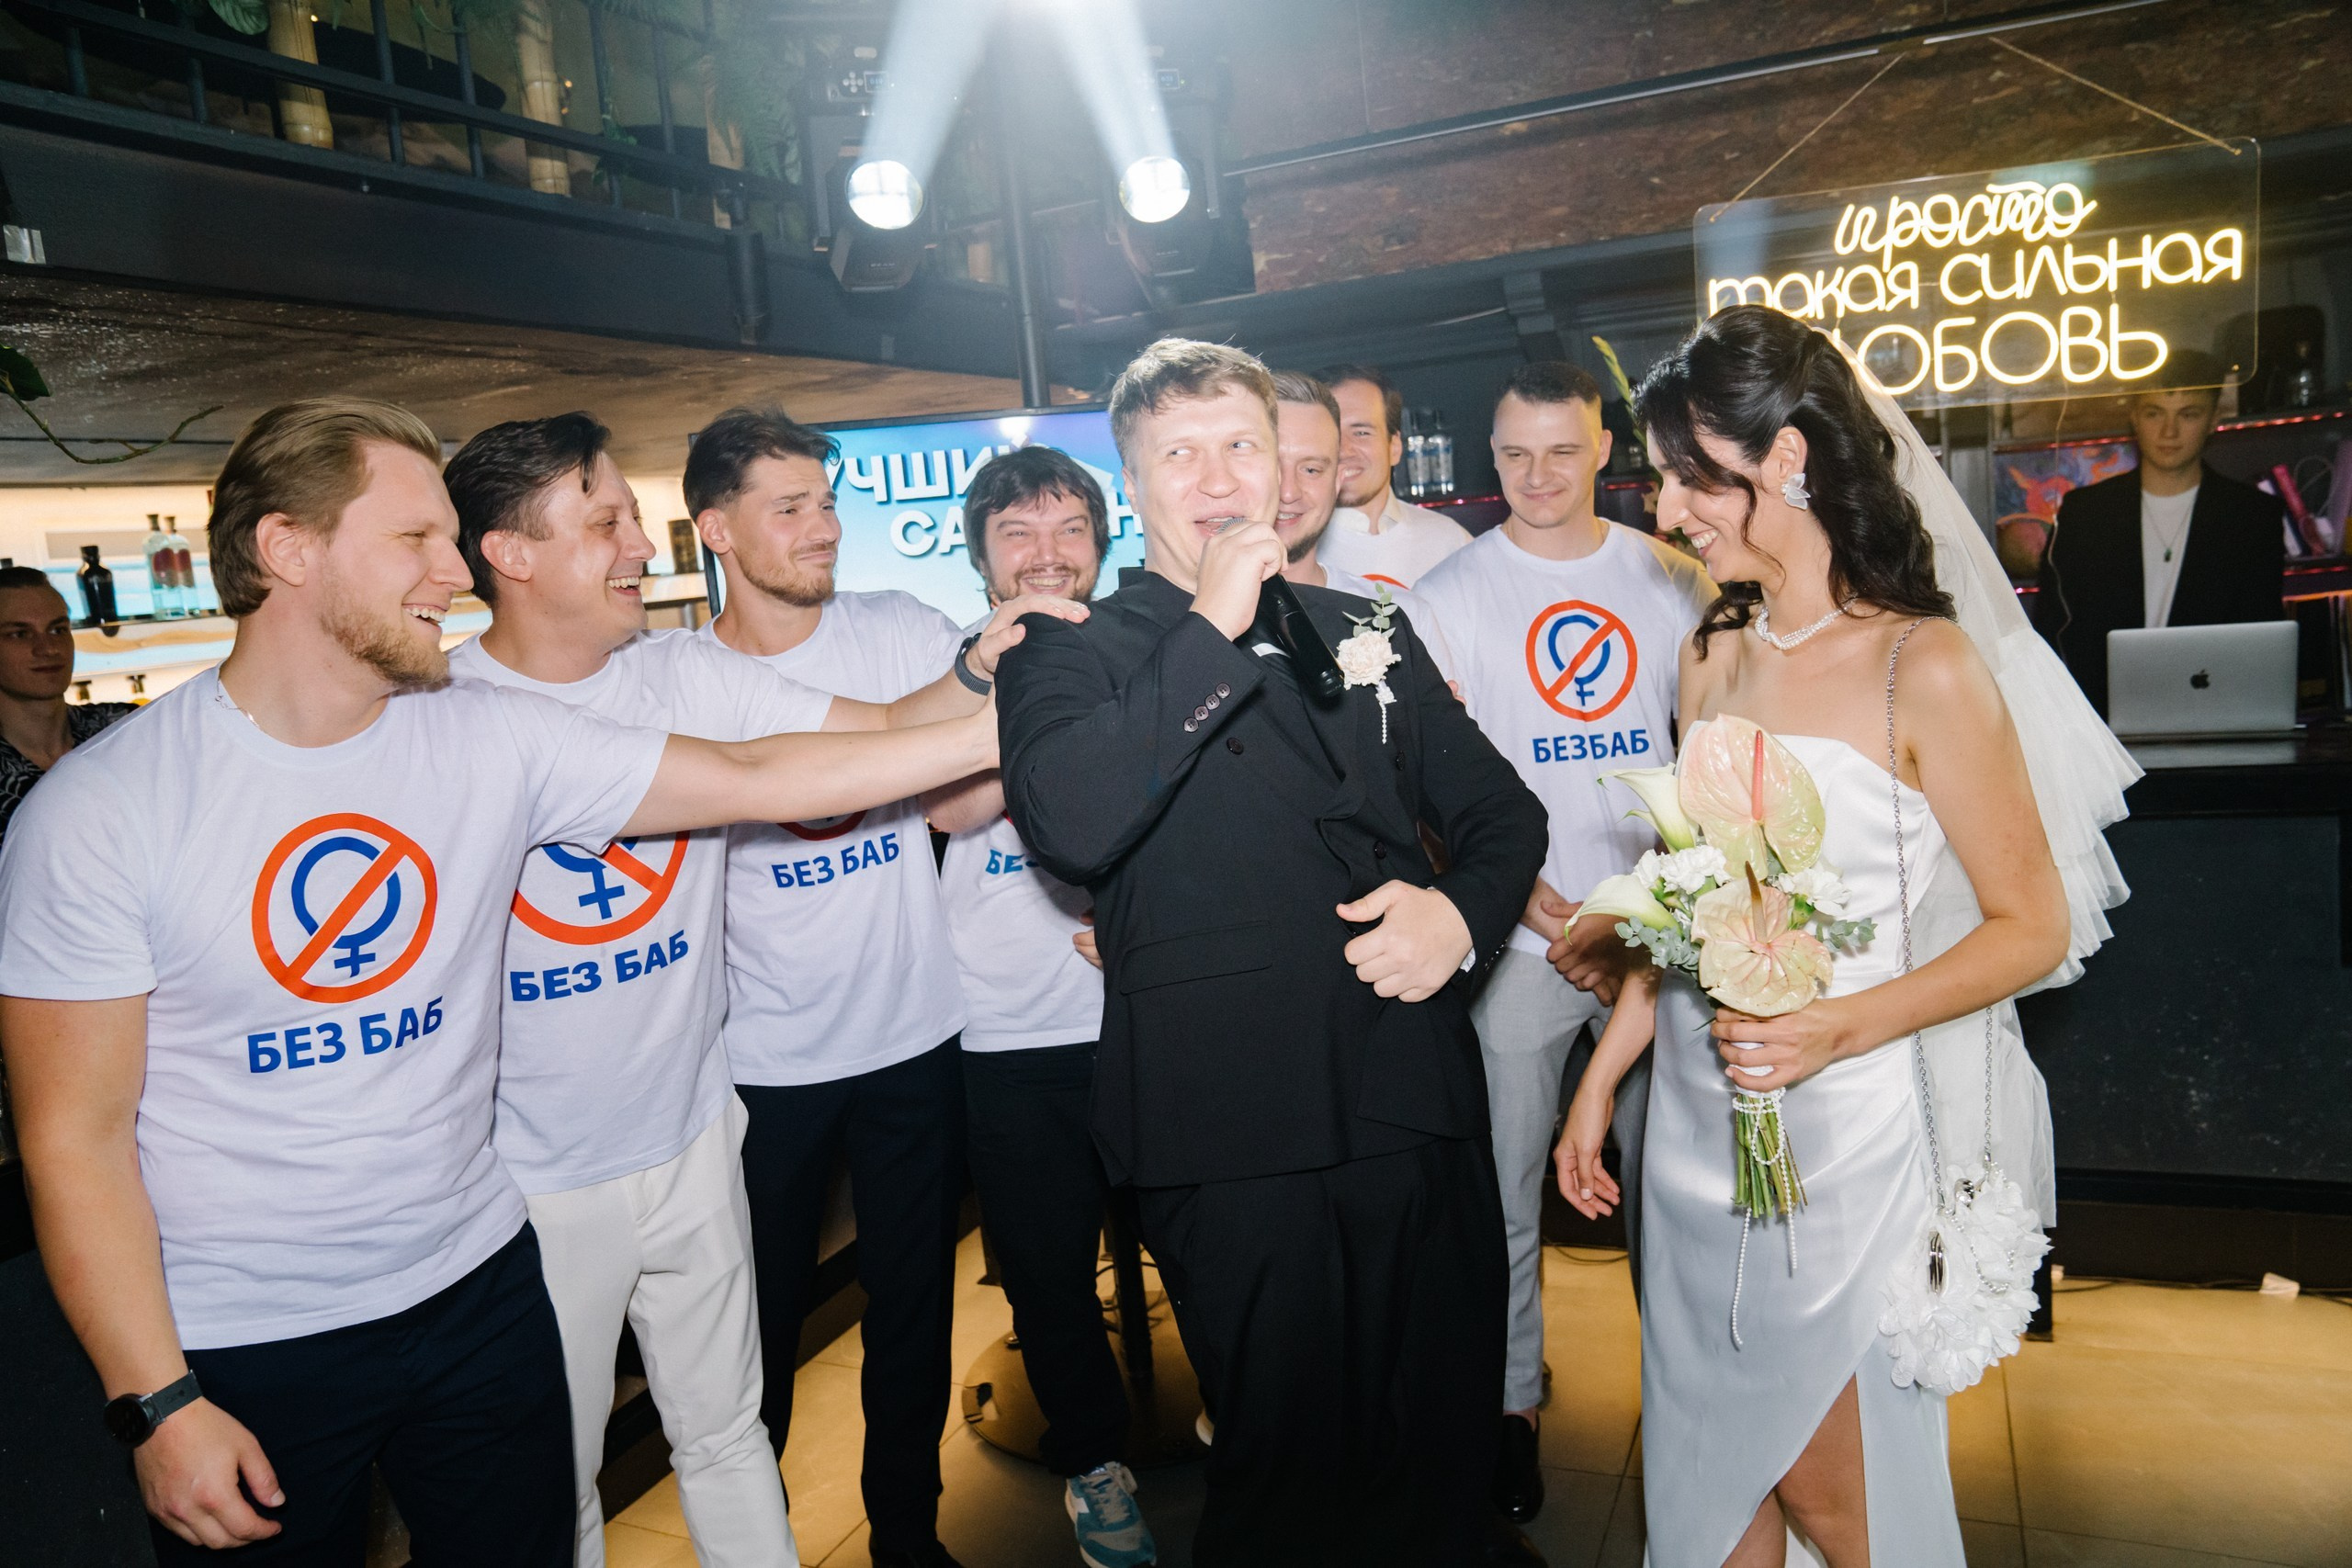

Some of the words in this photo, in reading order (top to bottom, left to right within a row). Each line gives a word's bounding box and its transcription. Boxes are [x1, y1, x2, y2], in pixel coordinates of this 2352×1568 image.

[1708, 260, 1920, 320] такая
[1939, 227, 2244, 306] сильная
[1832, 302, 2169, 397] ЮБОВЬ
[770, 854, 836, 889] БЕЗ
[839, 831, 900, 876] БАБ
[508, 960, 604, 1003] БЕЗ
[614, 929, 691, 985] БАБ
[246, 1021, 347, 1075] БЕЗ
[358, 996, 445, 1057] БАБ
